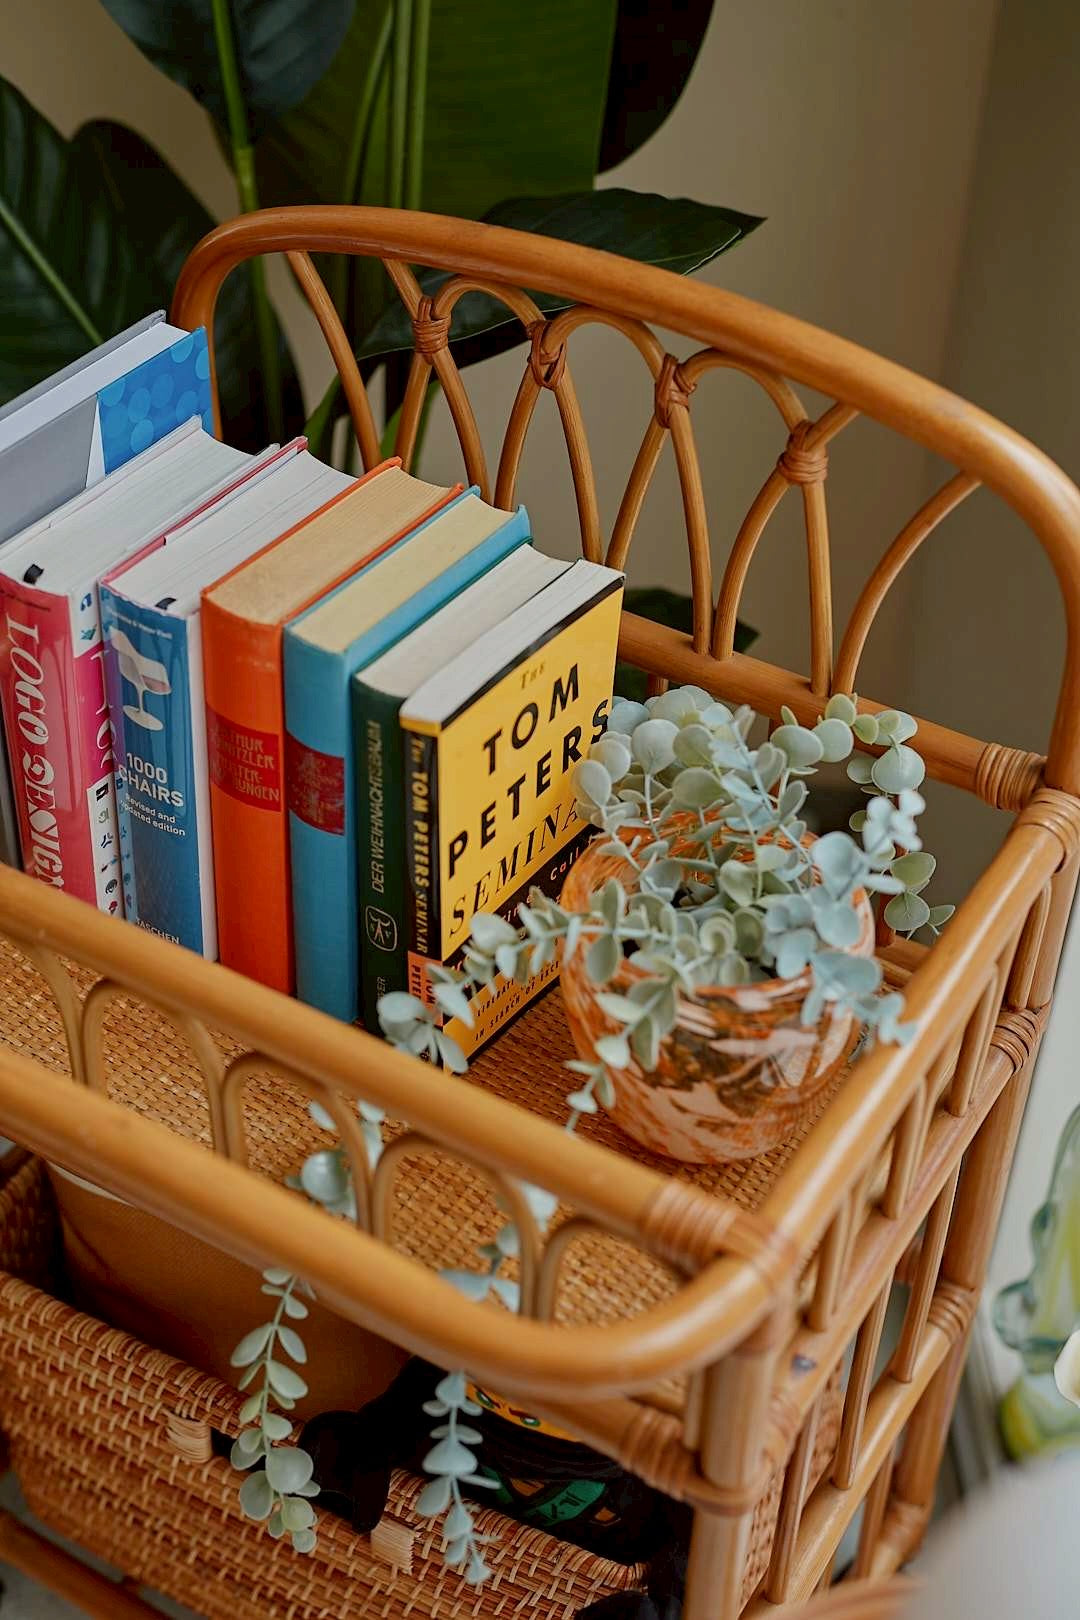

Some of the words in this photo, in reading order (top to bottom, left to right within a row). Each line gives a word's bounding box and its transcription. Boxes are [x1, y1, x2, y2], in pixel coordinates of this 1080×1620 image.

[6, 611, 50, 746] LOGO
[482, 662, 580, 777] TOM
[118, 764, 184, 807] CHAIRS
[126, 752, 168, 784] 1000
[411, 771, 429, 813] TOM
[448, 699, 609, 884] PETERS
[151, 820, 186, 837] edition
[157, 811, 176, 824] and
[413, 820, 430, 888] PETERS
[371, 861, 385, 894] DER
